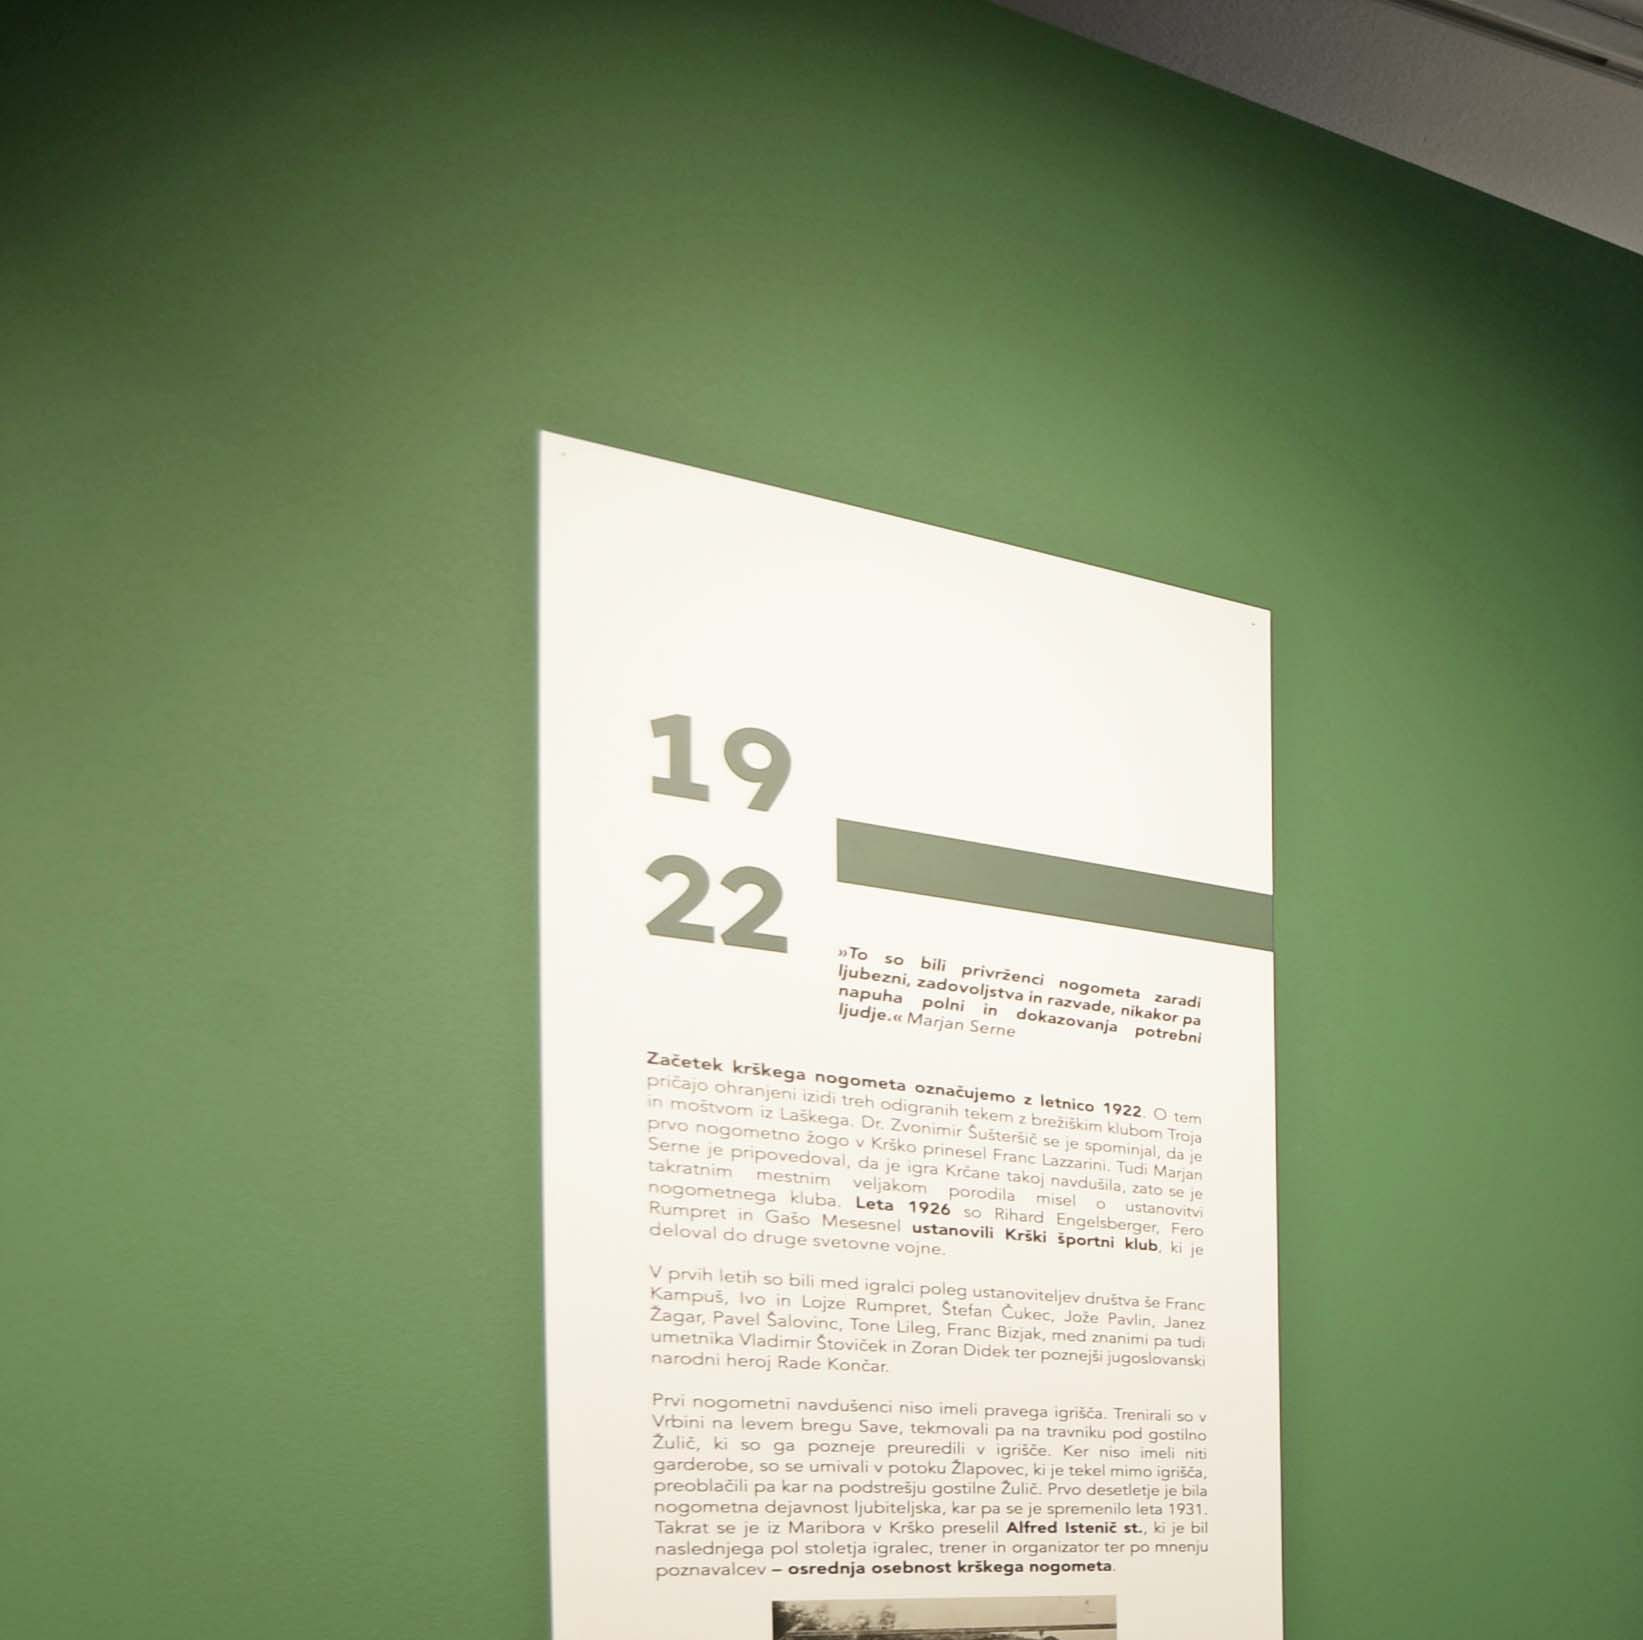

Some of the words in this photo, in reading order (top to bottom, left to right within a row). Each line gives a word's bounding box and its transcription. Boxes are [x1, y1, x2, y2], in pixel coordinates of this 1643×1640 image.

[649, 713, 792, 813] 19
[645, 854, 788, 954] 22
[838, 963, 910, 988] ljubezni,
[916, 977, 1024, 1001] zadovoljstva
[1027, 993, 1042, 1004] in
[1046, 996, 1115, 1016] razvade,
[1120, 1004, 1179, 1023] nikakor
[1182, 1015, 1201, 1028] pa
[884, 954, 904, 966] so
[920, 955, 946, 972] bili
[960, 965, 1044, 986] privrženci
[1058, 979, 1140, 1000] nogometa
[1153, 993, 1201, 1008] zaradi
[837, 986, 903, 1004] napuha
[921, 996, 964, 1012] polni
[982, 1005, 998, 1016] in
[1015, 1006, 1118, 1034] dokazovanja
[1134, 1026, 1202, 1044] potrebni
[906, 1010, 964, 1032] Marjan
[968, 1018, 1016, 1037] Serne
[646, 1050, 723, 1072] Začetek
[732, 1058, 806, 1083] krškega
[814, 1072, 906, 1092] nogometa
[914, 1083, 1016, 1104] označujemo
[1023, 1095, 1032, 1106] z
[1040, 1093, 1094, 1112] letnico
[1104, 1102, 1146, 1118] 1922.
[1153, 1107, 1167, 1120] O
[1173, 1112, 1202, 1124] tem
[648, 1182, 776, 1205] nogometnega
[790, 1190, 840, 1207] kluba.
[855, 1194, 894, 1212] Leta
[907, 1199, 951, 1216] 1926
[962, 1208, 982, 1218] so
[994, 1206, 1044, 1224] Rihard
[1056, 1211, 1159, 1235] Engelsberger,
[1171, 1221, 1204, 1237] Fero
[649, 1200, 726, 1220] Rumpret
[737, 1208, 753, 1221] in
[764, 1208, 810, 1225] Gašo
[822, 1213, 900, 1232] Mesesnel
[911, 1222, 994, 1239] ustanovili
[1004, 1226, 1046, 1243] Krški
[1056, 1234, 1114, 1248] športni
[1124, 1235, 1161, 1253] klub,
[1170, 1240, 1182, 1253] ki
[1190, 1243, 1204, 1259] je
[649, 1263, 662, 1278] V
[667, 1266, 712, 1283] prvih
[718, 1267, 758, 1284] letih
[762, 1274, 783, 1286] so
[788, 1271, 814, 1288] bili
[820, 1275, 859, 1290] med
[864, 1278, 914, 1296] igralci
[918, 1280, 967, 1301] poleg
[972, 1287, 1081, 1306] ustanoviteljev
[1083, 1290, 1140, 1308] društva
[1143, 1295, 1160, 1308] še
[1164, 1295, 1206, 1312] Franc
[650, 1351, 720, 1366] narodni
[725, 1351, 771, 1372] heroj
[777, 1354, 822, 1370] Rade
[826, 1356, 888, 1373] Končar.
[655, 1561, 766, 1580] poznavalcev
[787, 1560, 865, 1578] osrednja
[870, 1559, 952, 1574] osebnost
[956, 1558, 1024, 1576] krškega
[1029, 1560, 1116, 1576] nogometa.
